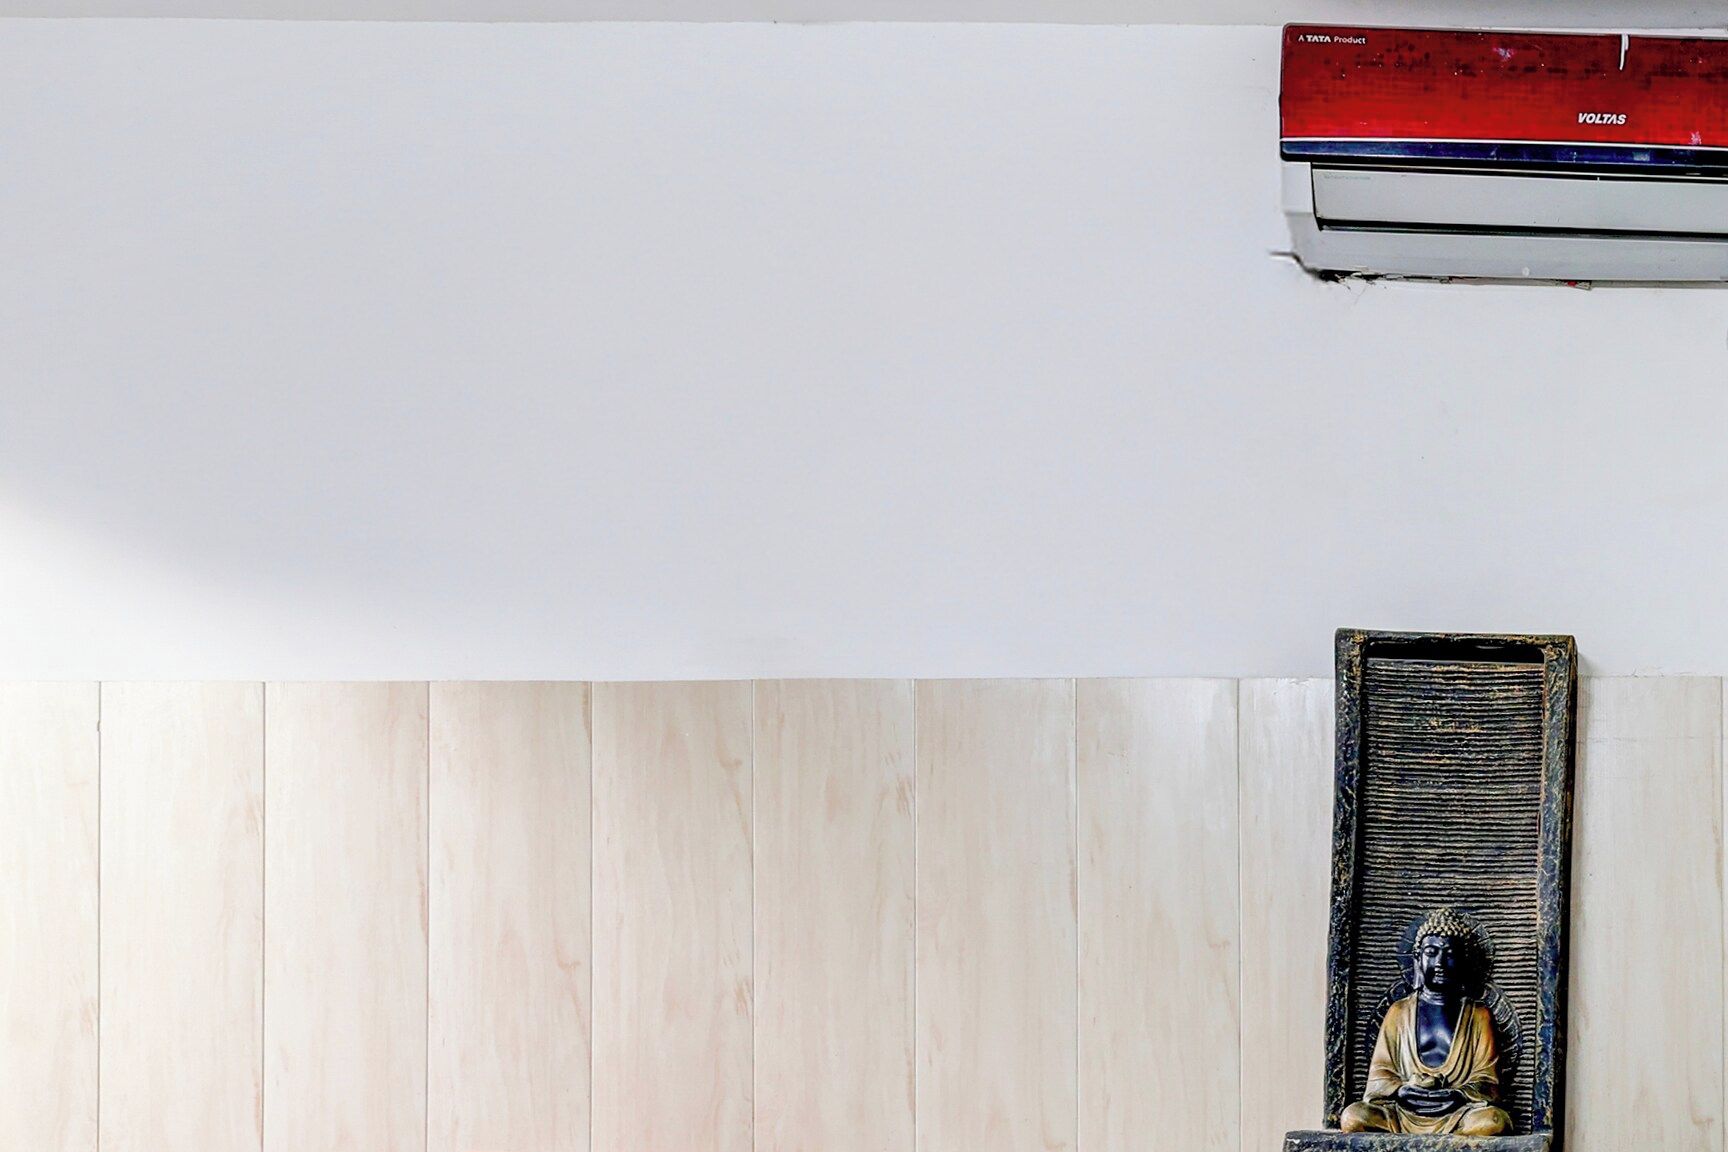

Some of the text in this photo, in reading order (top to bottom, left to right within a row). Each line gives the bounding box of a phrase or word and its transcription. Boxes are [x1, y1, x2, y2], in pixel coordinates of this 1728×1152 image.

[1298, 34, 1366, 44] A TATA Product
[1578, 112, 1627, 125] VOLTAS
